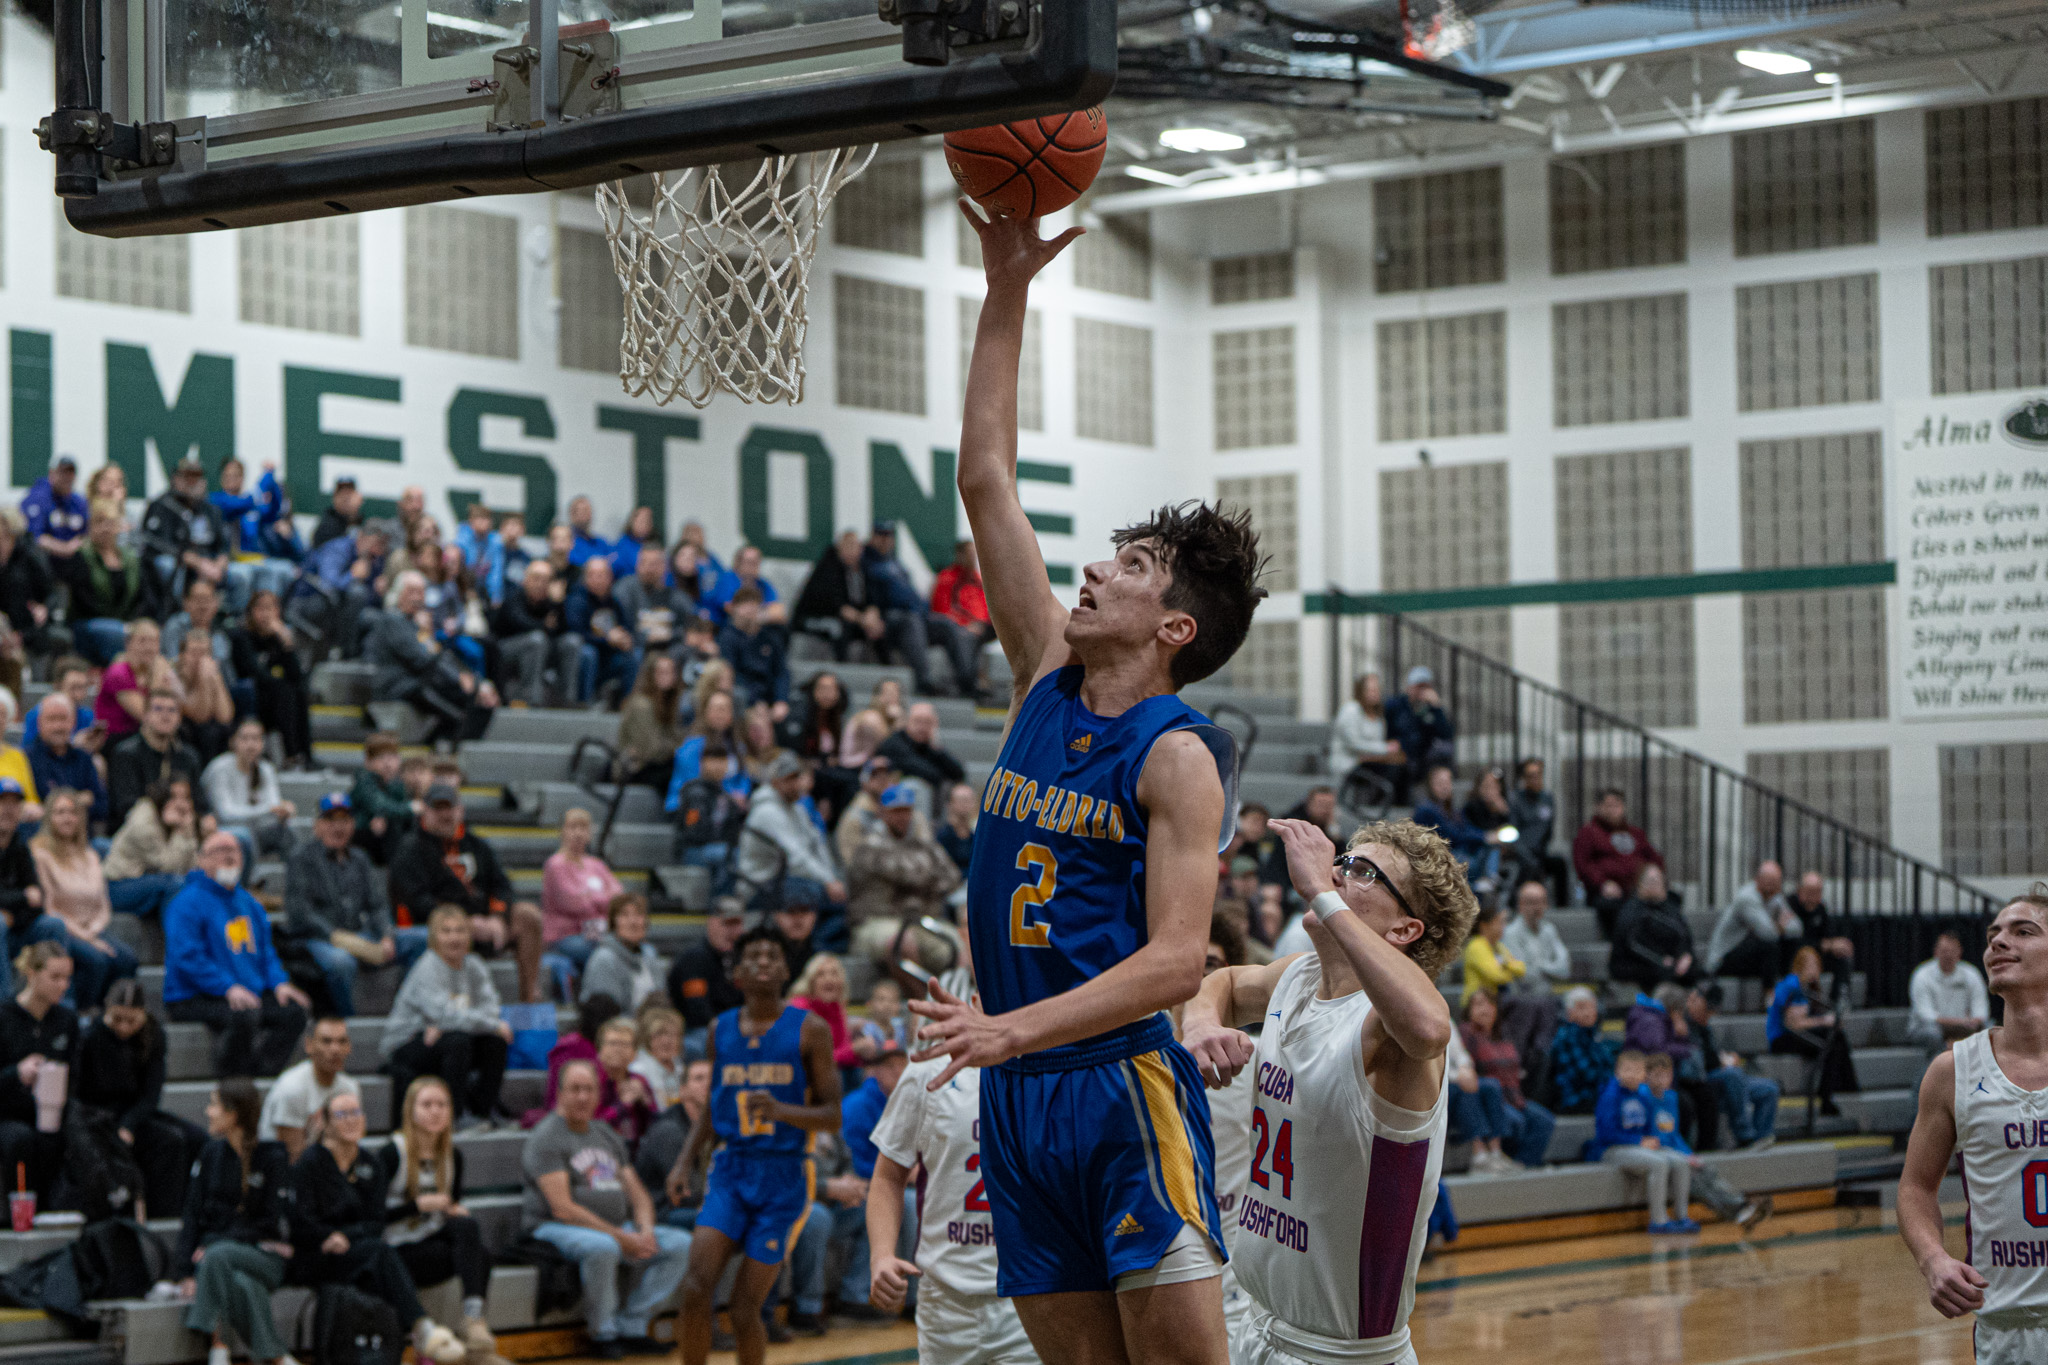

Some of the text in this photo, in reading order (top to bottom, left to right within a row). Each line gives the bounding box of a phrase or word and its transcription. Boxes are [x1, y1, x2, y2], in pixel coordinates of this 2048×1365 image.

[1903, 416, 1991, 450] Alma
[11, 329, 1073, 585] IMESTONE
[1994, 469, 2013, 491] in
[1911, 501, 2040, 528] Colors Green
[1911, 535, 1947, 559] Lies
[1952, 539, 1967, 556] a
[1973, 529, 2029, 553] school
[1913, 562, 2037, 597] Dignified and
[1908, 596, 1966, 620] Behold
[1912, 625, 1982, 656] Singing
[1990, 624, 2021, 645] out
[1912, 685, 1952, 708] Will
[1959, 684, 2005, 706] shine
[983, 766, 1125, 843] OTTO-ELDRED
[1009, 841, 1058, 948] 2
[1258, 1061, 1294, 1105] CUBA
[1250, 1105, 1294, 1201] 24
[947, 1221, 996, 1246] RUSH
[1113, 1225, 1144, 1237] adidas
[1239, 1194, 1308, 1253] USHFORD
[1991, 1240, 2048, 1268] RUSH
